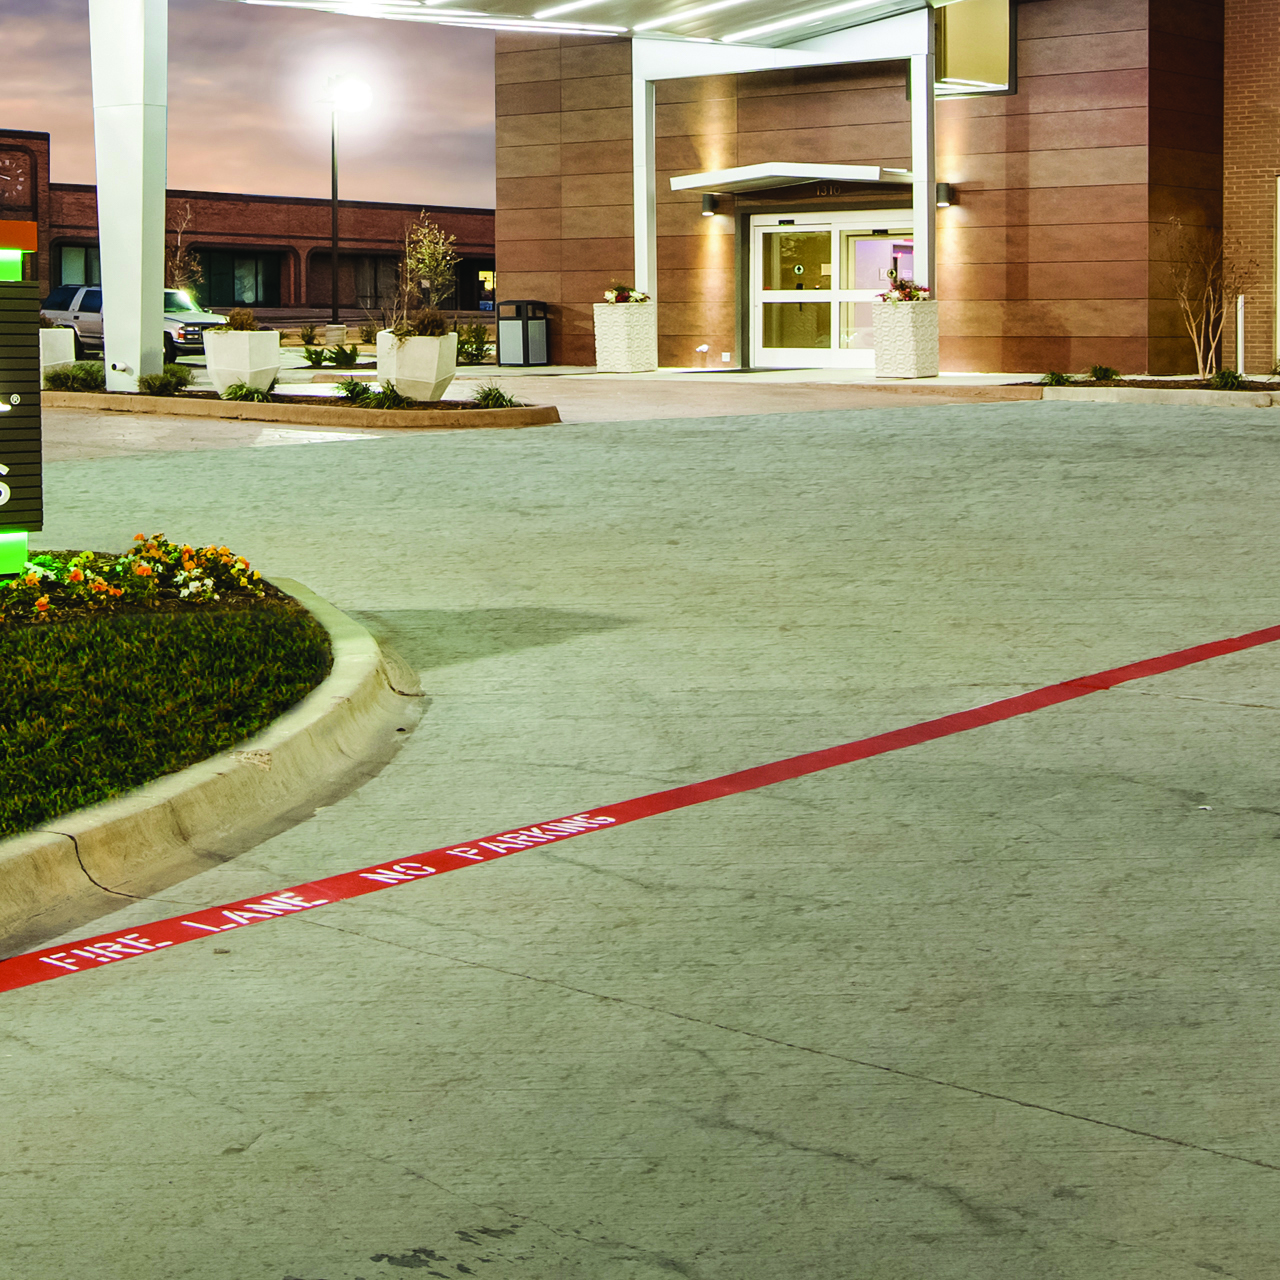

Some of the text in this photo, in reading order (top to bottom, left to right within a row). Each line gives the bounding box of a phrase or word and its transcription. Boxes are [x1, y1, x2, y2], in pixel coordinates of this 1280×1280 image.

[816, 185, 841, 196] 1310
[39, 813, 617, 971] FIRE LANE NO PARKING
